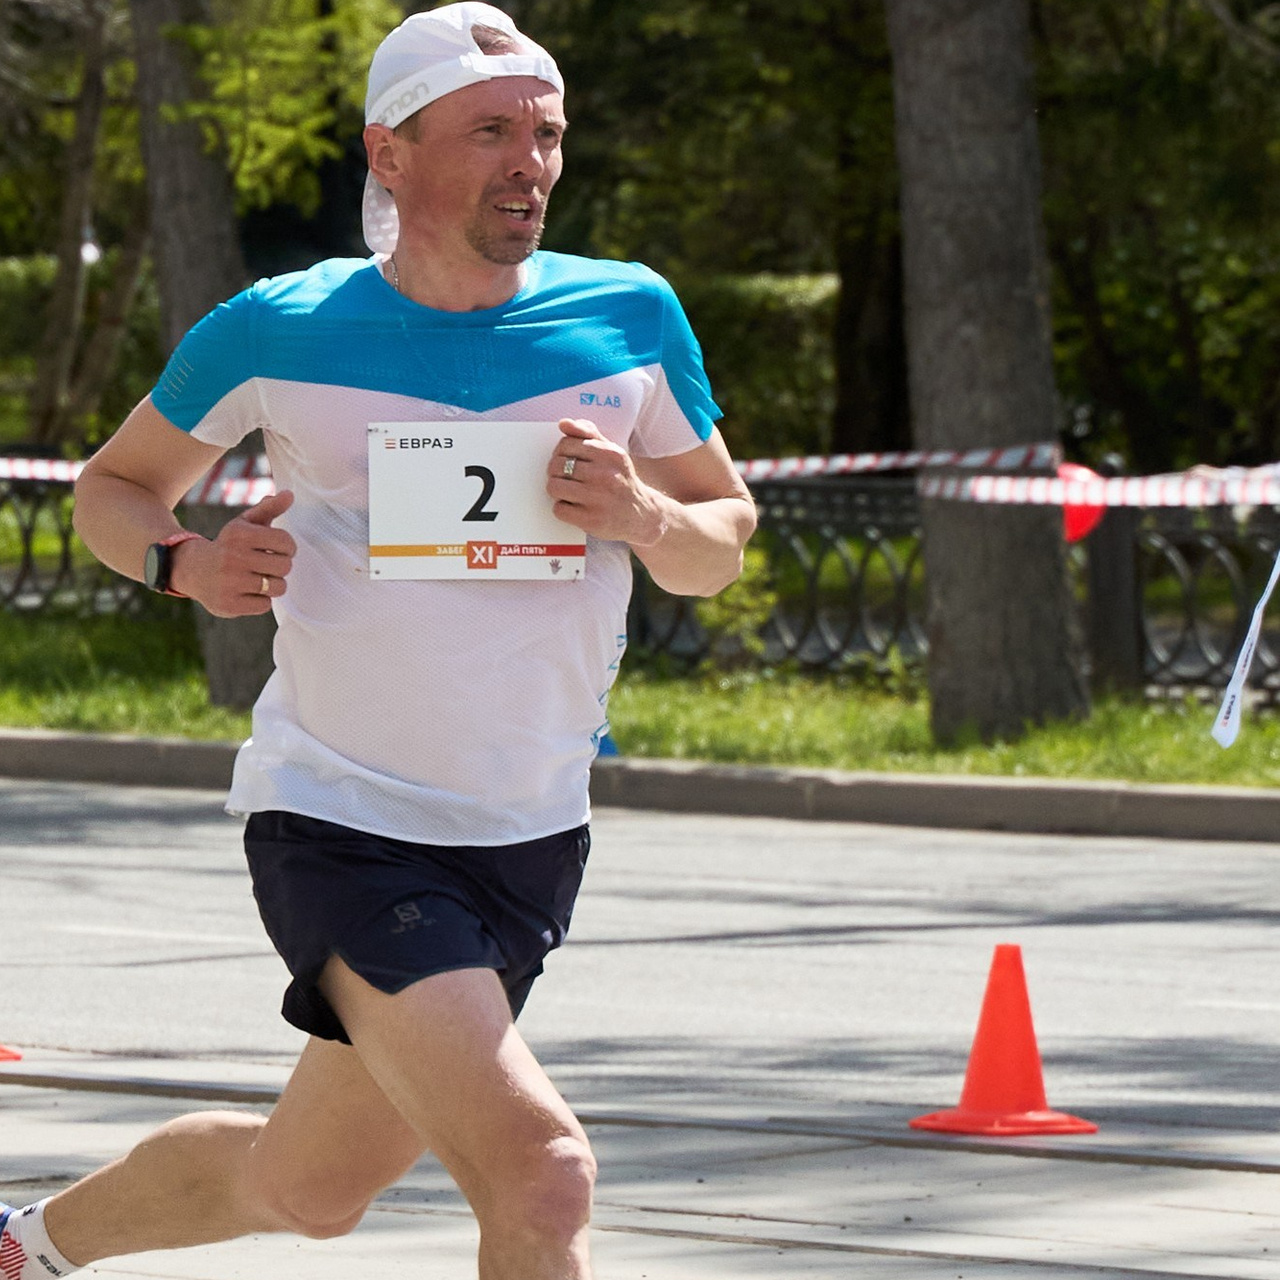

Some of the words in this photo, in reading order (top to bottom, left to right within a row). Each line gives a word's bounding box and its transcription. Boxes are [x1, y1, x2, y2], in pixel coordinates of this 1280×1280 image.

[399, 438, 454, 449] ЕВРАЗ
[462, 465, 499, 522] 2
[436, 546, 464, 555] ЗАБЕГ
[472, 546, 493, 564] XI
[500, 544, 520, 555] ДАЙ
[522, 546, 547, 555] ПЯТЬ!
